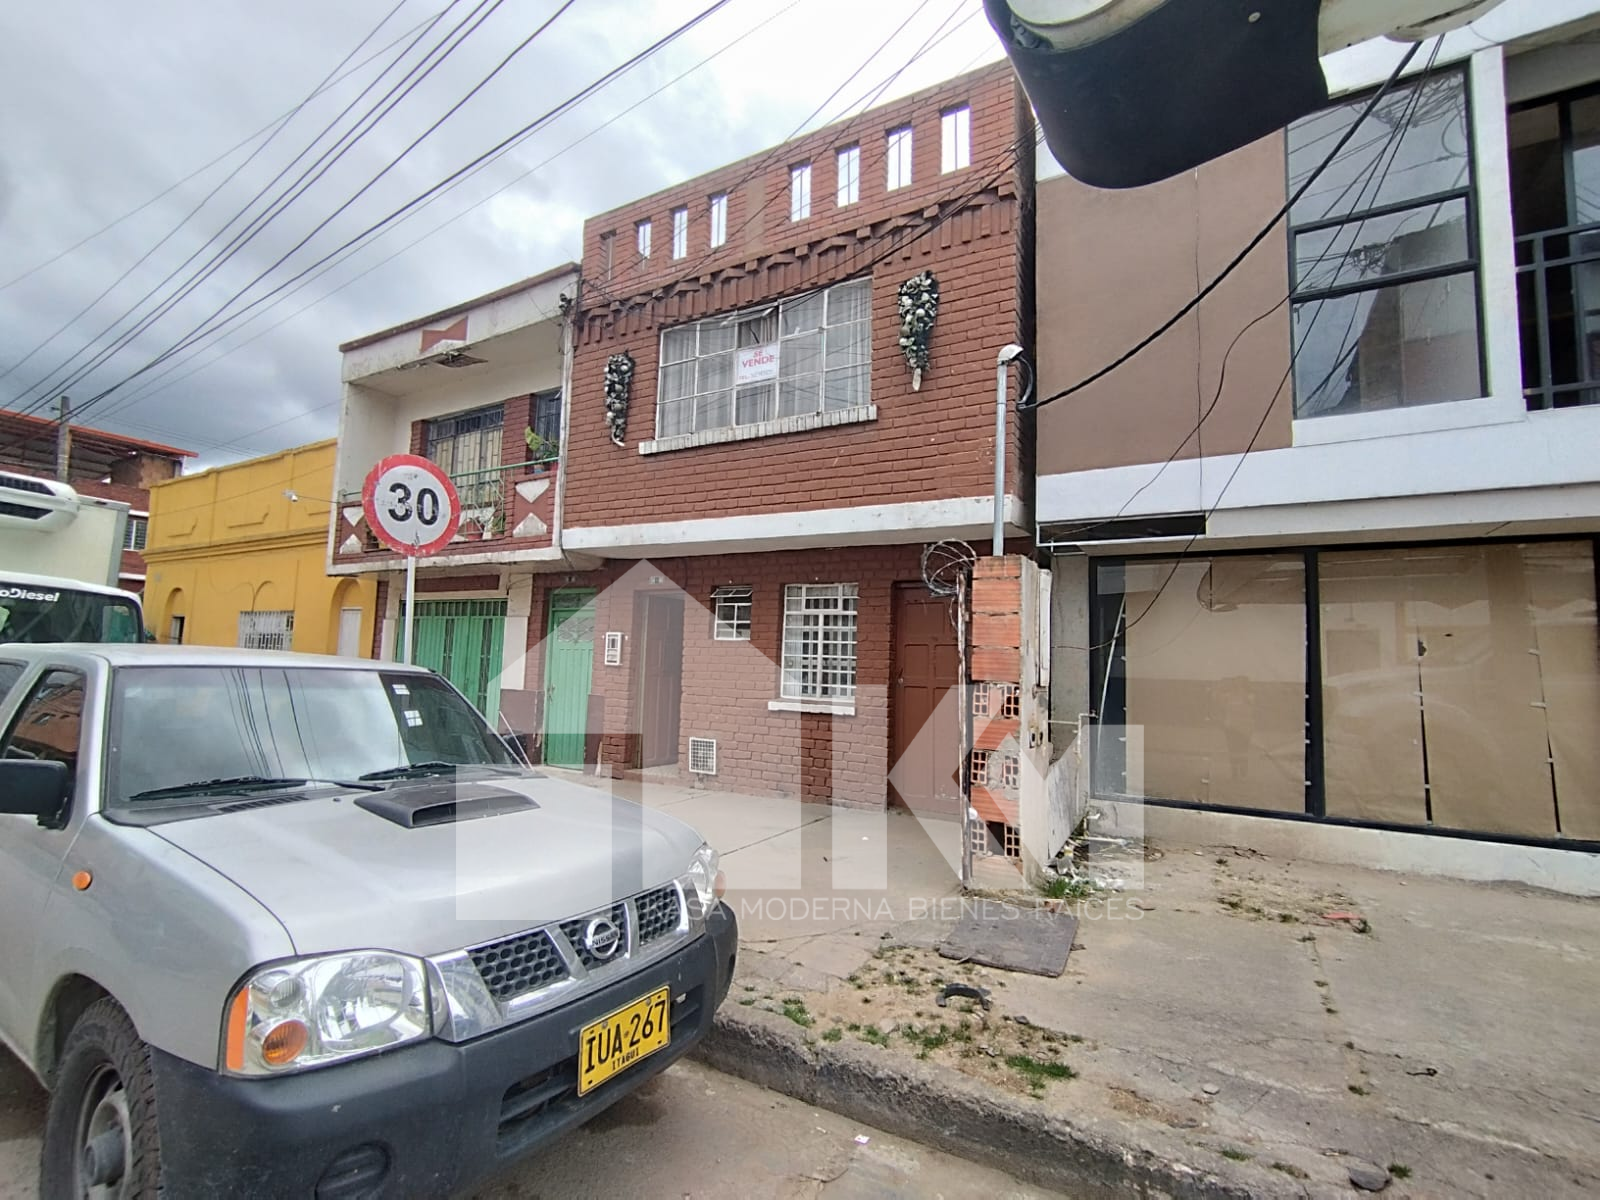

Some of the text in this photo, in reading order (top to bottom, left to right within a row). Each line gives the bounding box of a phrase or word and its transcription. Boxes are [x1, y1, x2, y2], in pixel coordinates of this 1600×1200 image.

[742, 355, 774, 368] VENDE
[388, 483, 440, 526] 30
[592, 930, 619, 947] NISS
[611, 1047, 640, 1071] ITAGUI
